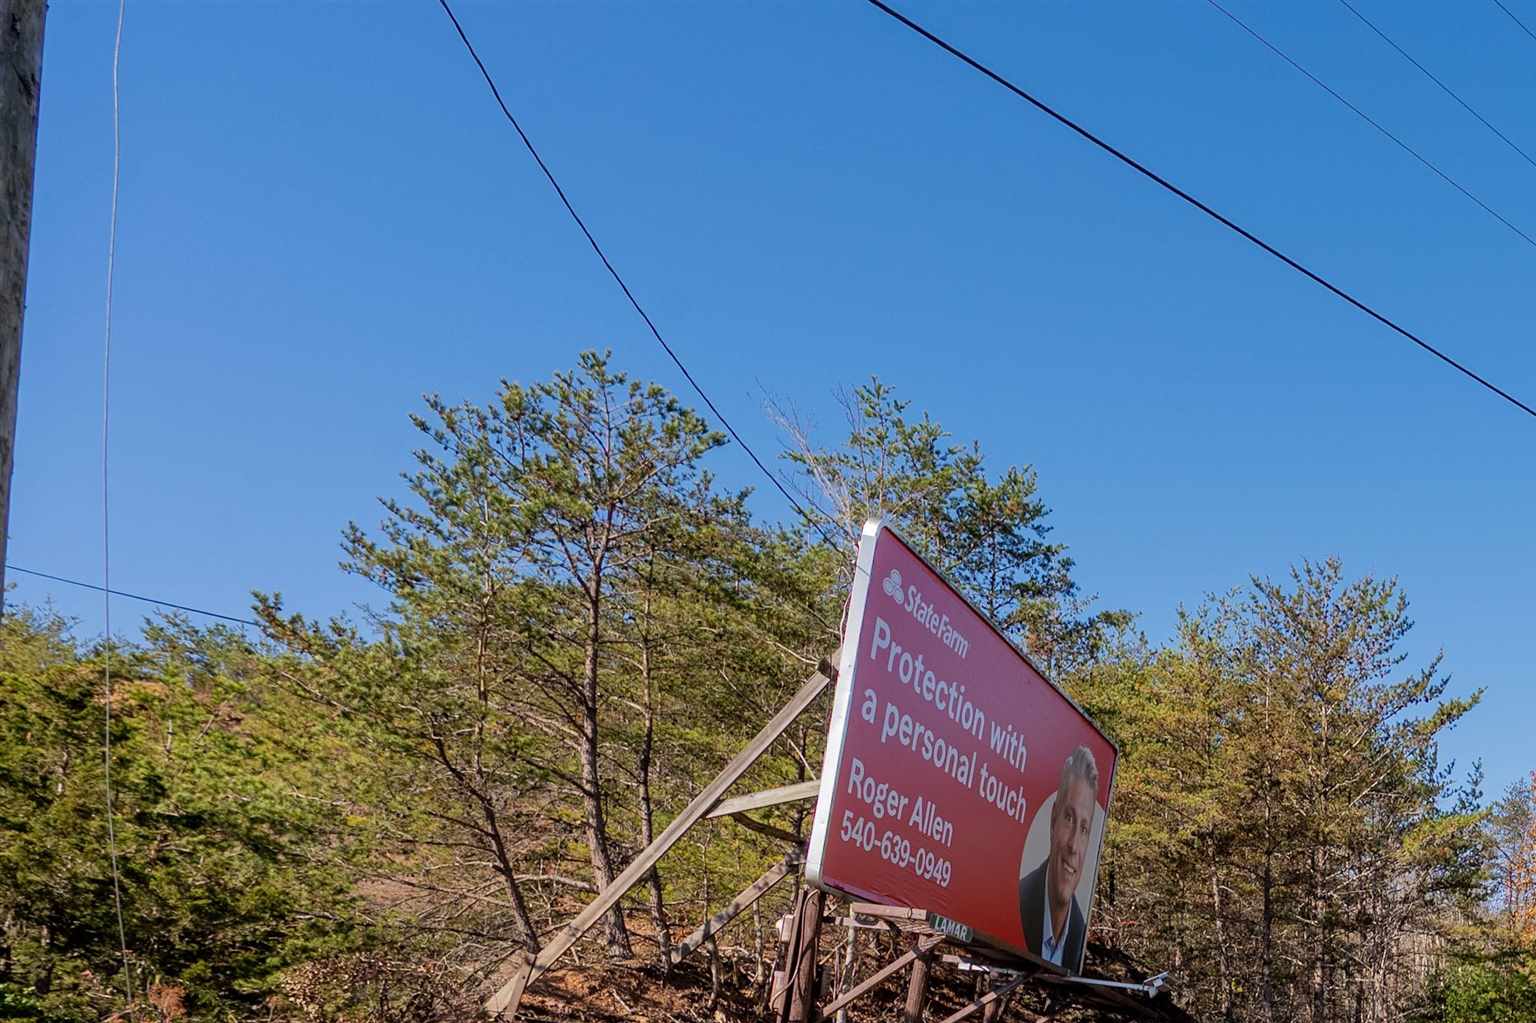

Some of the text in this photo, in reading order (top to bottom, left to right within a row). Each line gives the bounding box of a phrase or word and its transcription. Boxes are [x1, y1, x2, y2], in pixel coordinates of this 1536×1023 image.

[870, 616, 1027, 773] Protection with
[861, 688, 1027, 824] a personal touch
[847, 757, 954, 848] Roger Allen
[840, 809, 952, 888] 540-639-0949
[934, 915, 968, 941] LAMAR
